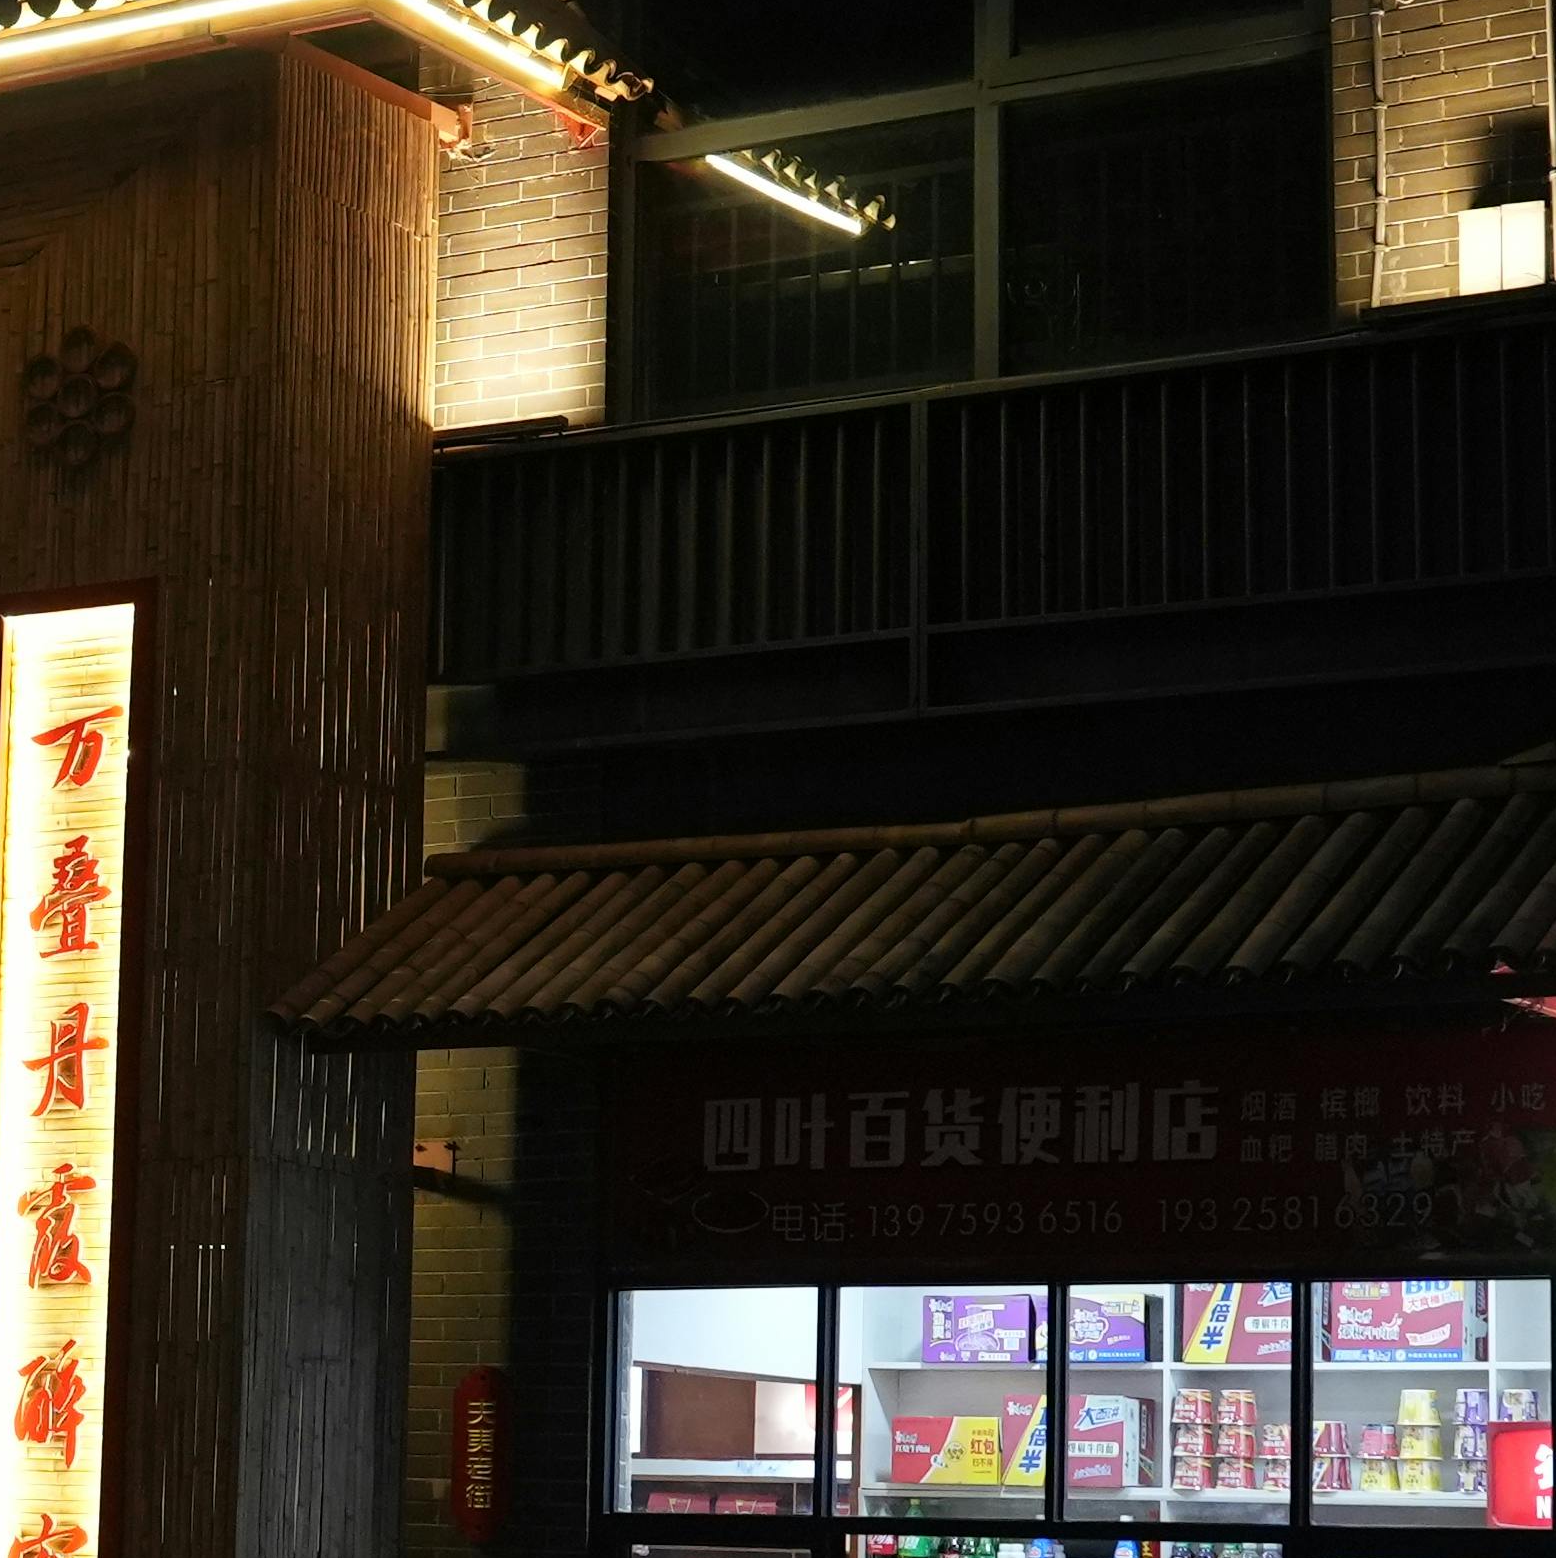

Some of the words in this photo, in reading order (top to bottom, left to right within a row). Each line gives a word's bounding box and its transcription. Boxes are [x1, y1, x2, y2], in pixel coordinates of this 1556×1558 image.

[1239, 1091, 1297, 1123] 烟酒
[1405, 1082, 1466, 1117] 饮料
[1490, 1082, 1546, 1113] 小吃
[703, 1078, 1220, 1173] 四叶百货便利店
[868, 1204, 925, 1236] 139
[937, 1202, 1025, 1235] 7593
[1038, 1200, 1123, 1234] 6516
[1159, 1197, 1217, 1233] 193
[1233, 1196, 1319, 1231] 2581
[1334, 1193, 1434, 1230] 6329
